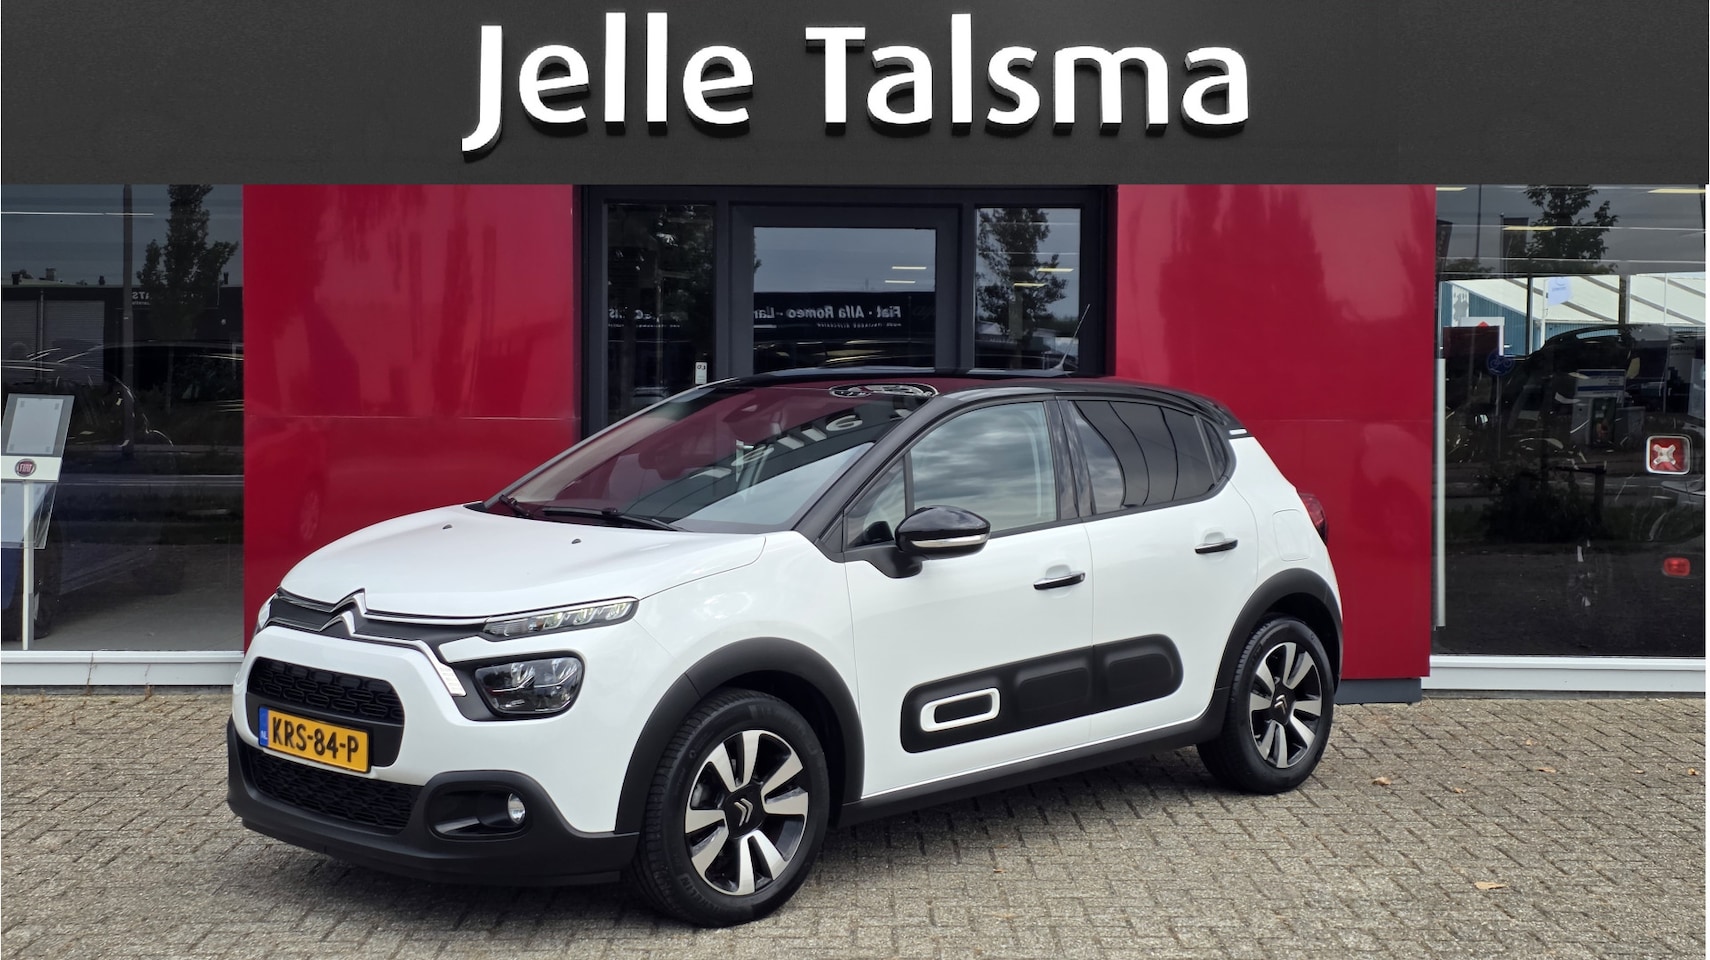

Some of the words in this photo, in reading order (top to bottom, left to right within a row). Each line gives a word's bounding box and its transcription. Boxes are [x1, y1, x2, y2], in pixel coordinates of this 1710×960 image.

[461, 11, 754, 155] Jelle
[805, 12, 1251, 130] Talsma
[272, 717, 359, 762] KRS-84-P
